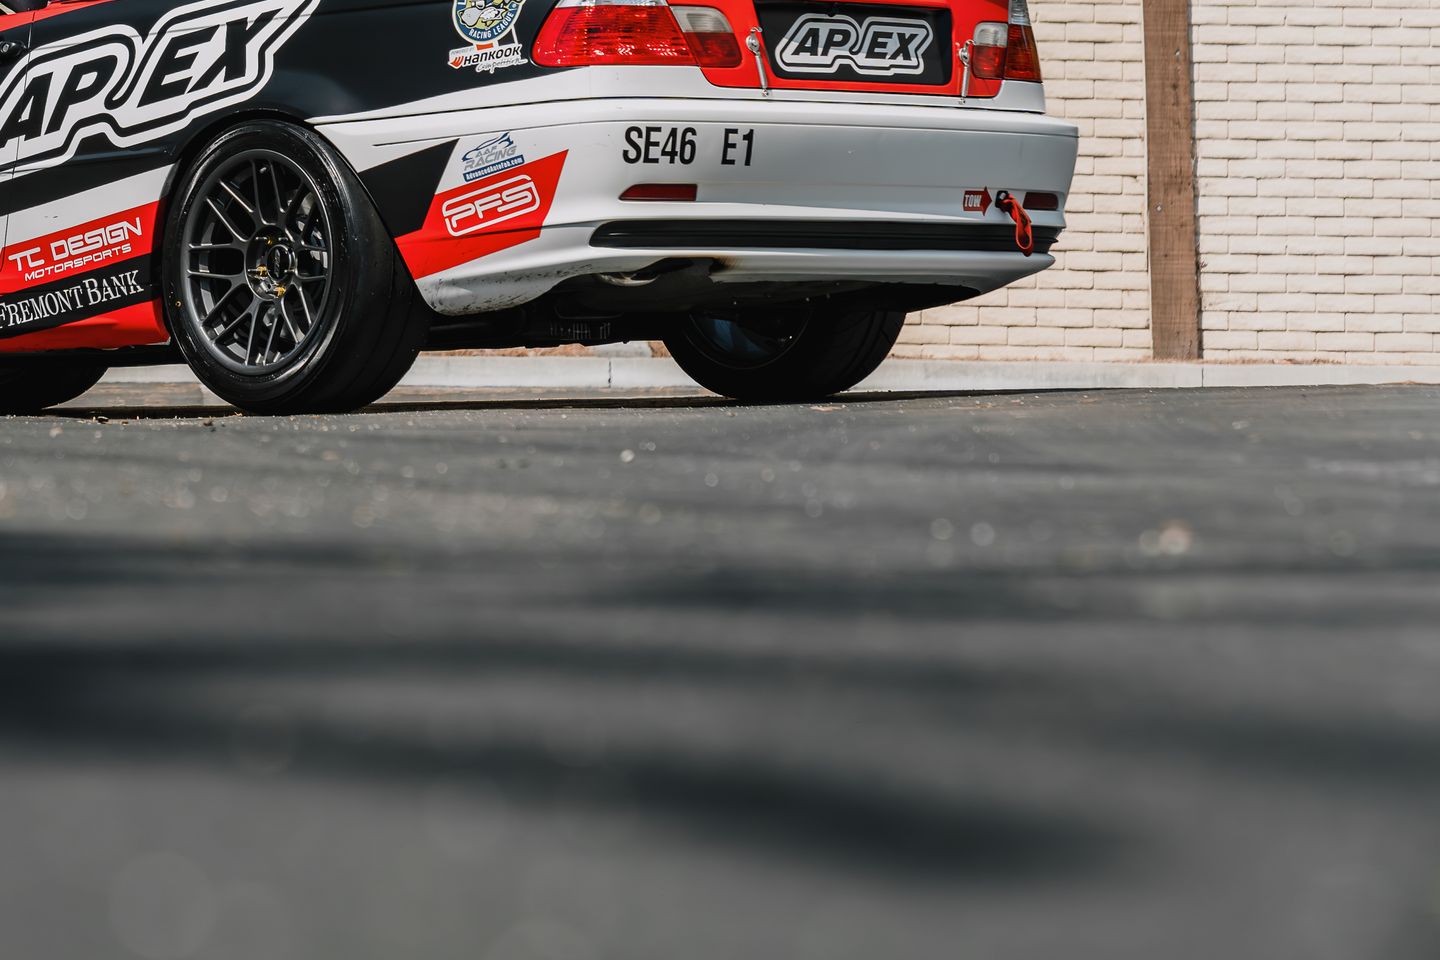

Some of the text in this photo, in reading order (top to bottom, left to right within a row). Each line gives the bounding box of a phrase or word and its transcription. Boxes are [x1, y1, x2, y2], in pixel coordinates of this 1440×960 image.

[468, 10, 514, 40] RACING LEAGUE
[787, 24, 923, 65] APEX
[463, 145, 518, 172] RACING
[475, 145, 498, 158] AAF
[622, 125, 754, 166] SE46 E1
[444, 180, 536, 229] PFS
[964, 193, 982, 208] TOW
[8, 217, 143, 272] TC DESIGN
[24, 243, 132, 282] MOTORSPORTS
[82, 270, 144, 306] BANK
